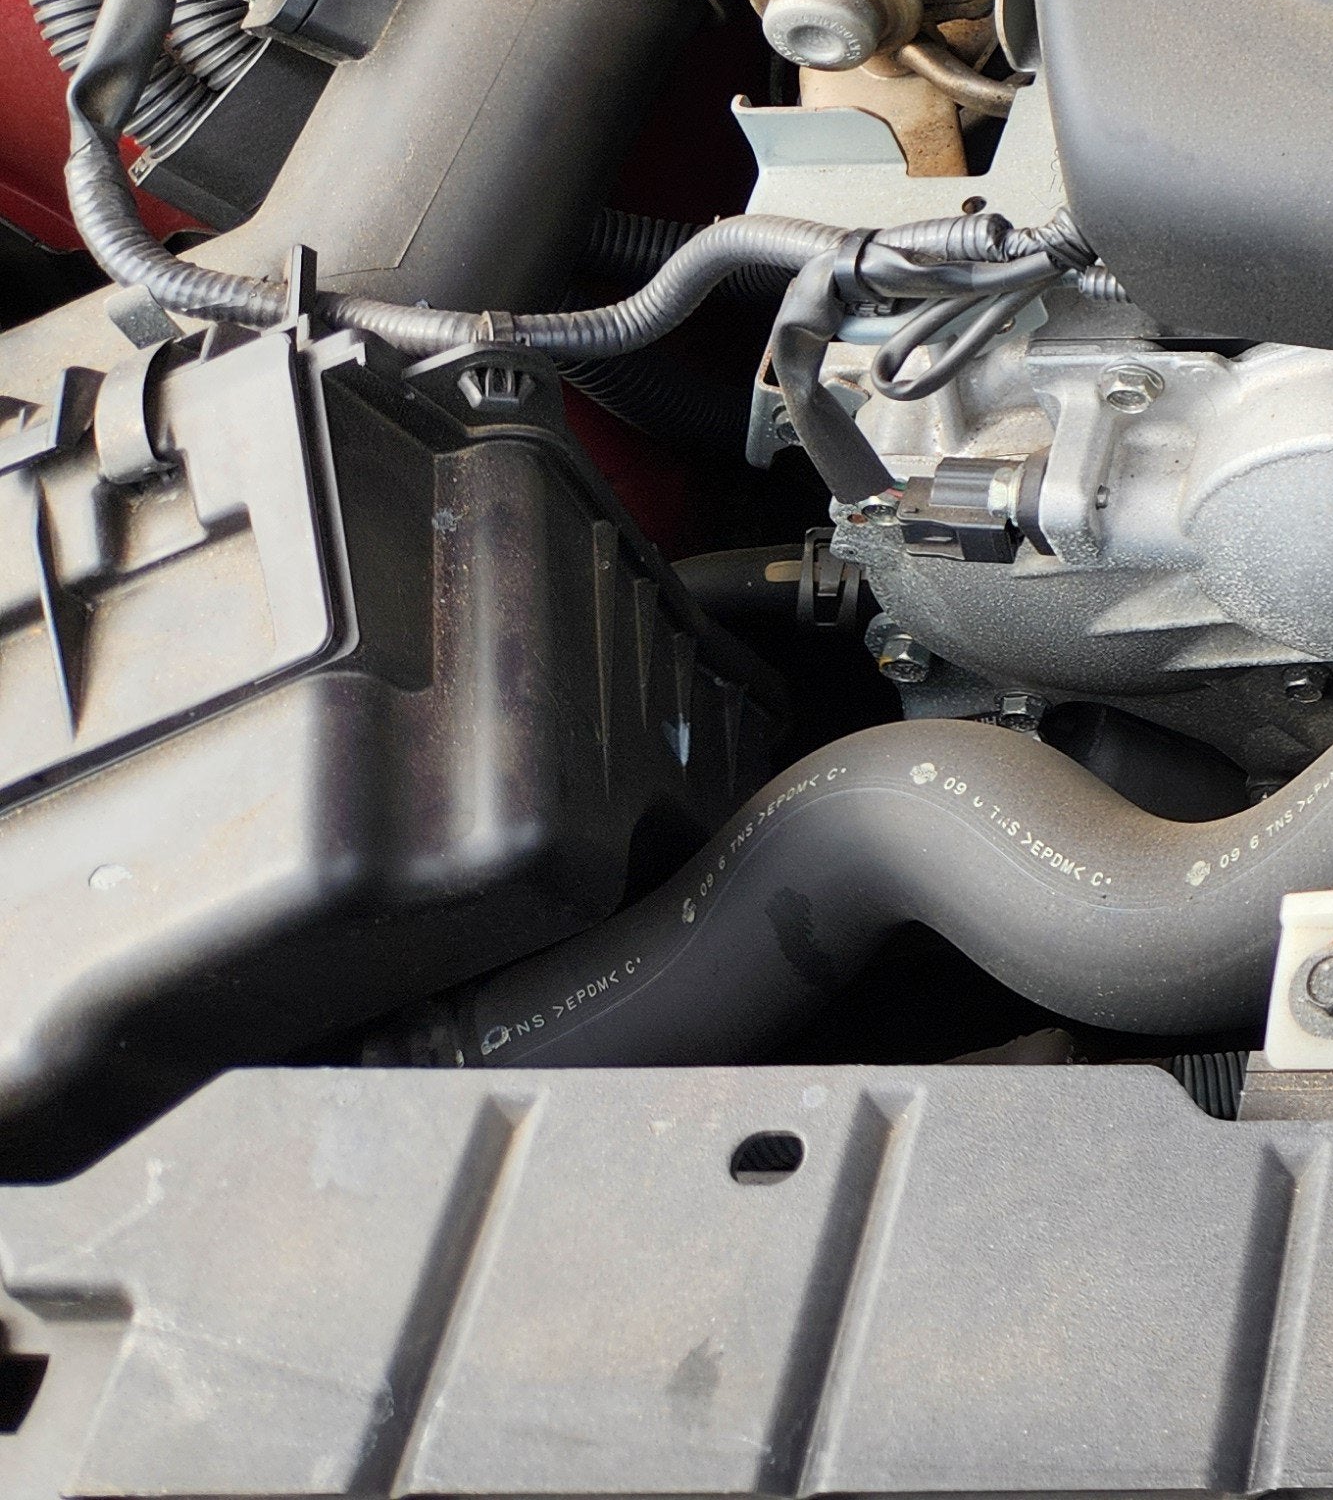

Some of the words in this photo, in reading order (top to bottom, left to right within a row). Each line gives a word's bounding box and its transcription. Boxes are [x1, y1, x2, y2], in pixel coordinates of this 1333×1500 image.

[943, 777, 967, 795] 09
[700, 873, 714, 897] 09
[730, 822, 753, 854] TNS
[1220, 848, 1240, 868] 09
[1250, 834, 1259, 849] 6
[1265, 809, 1293, 837] TNS
